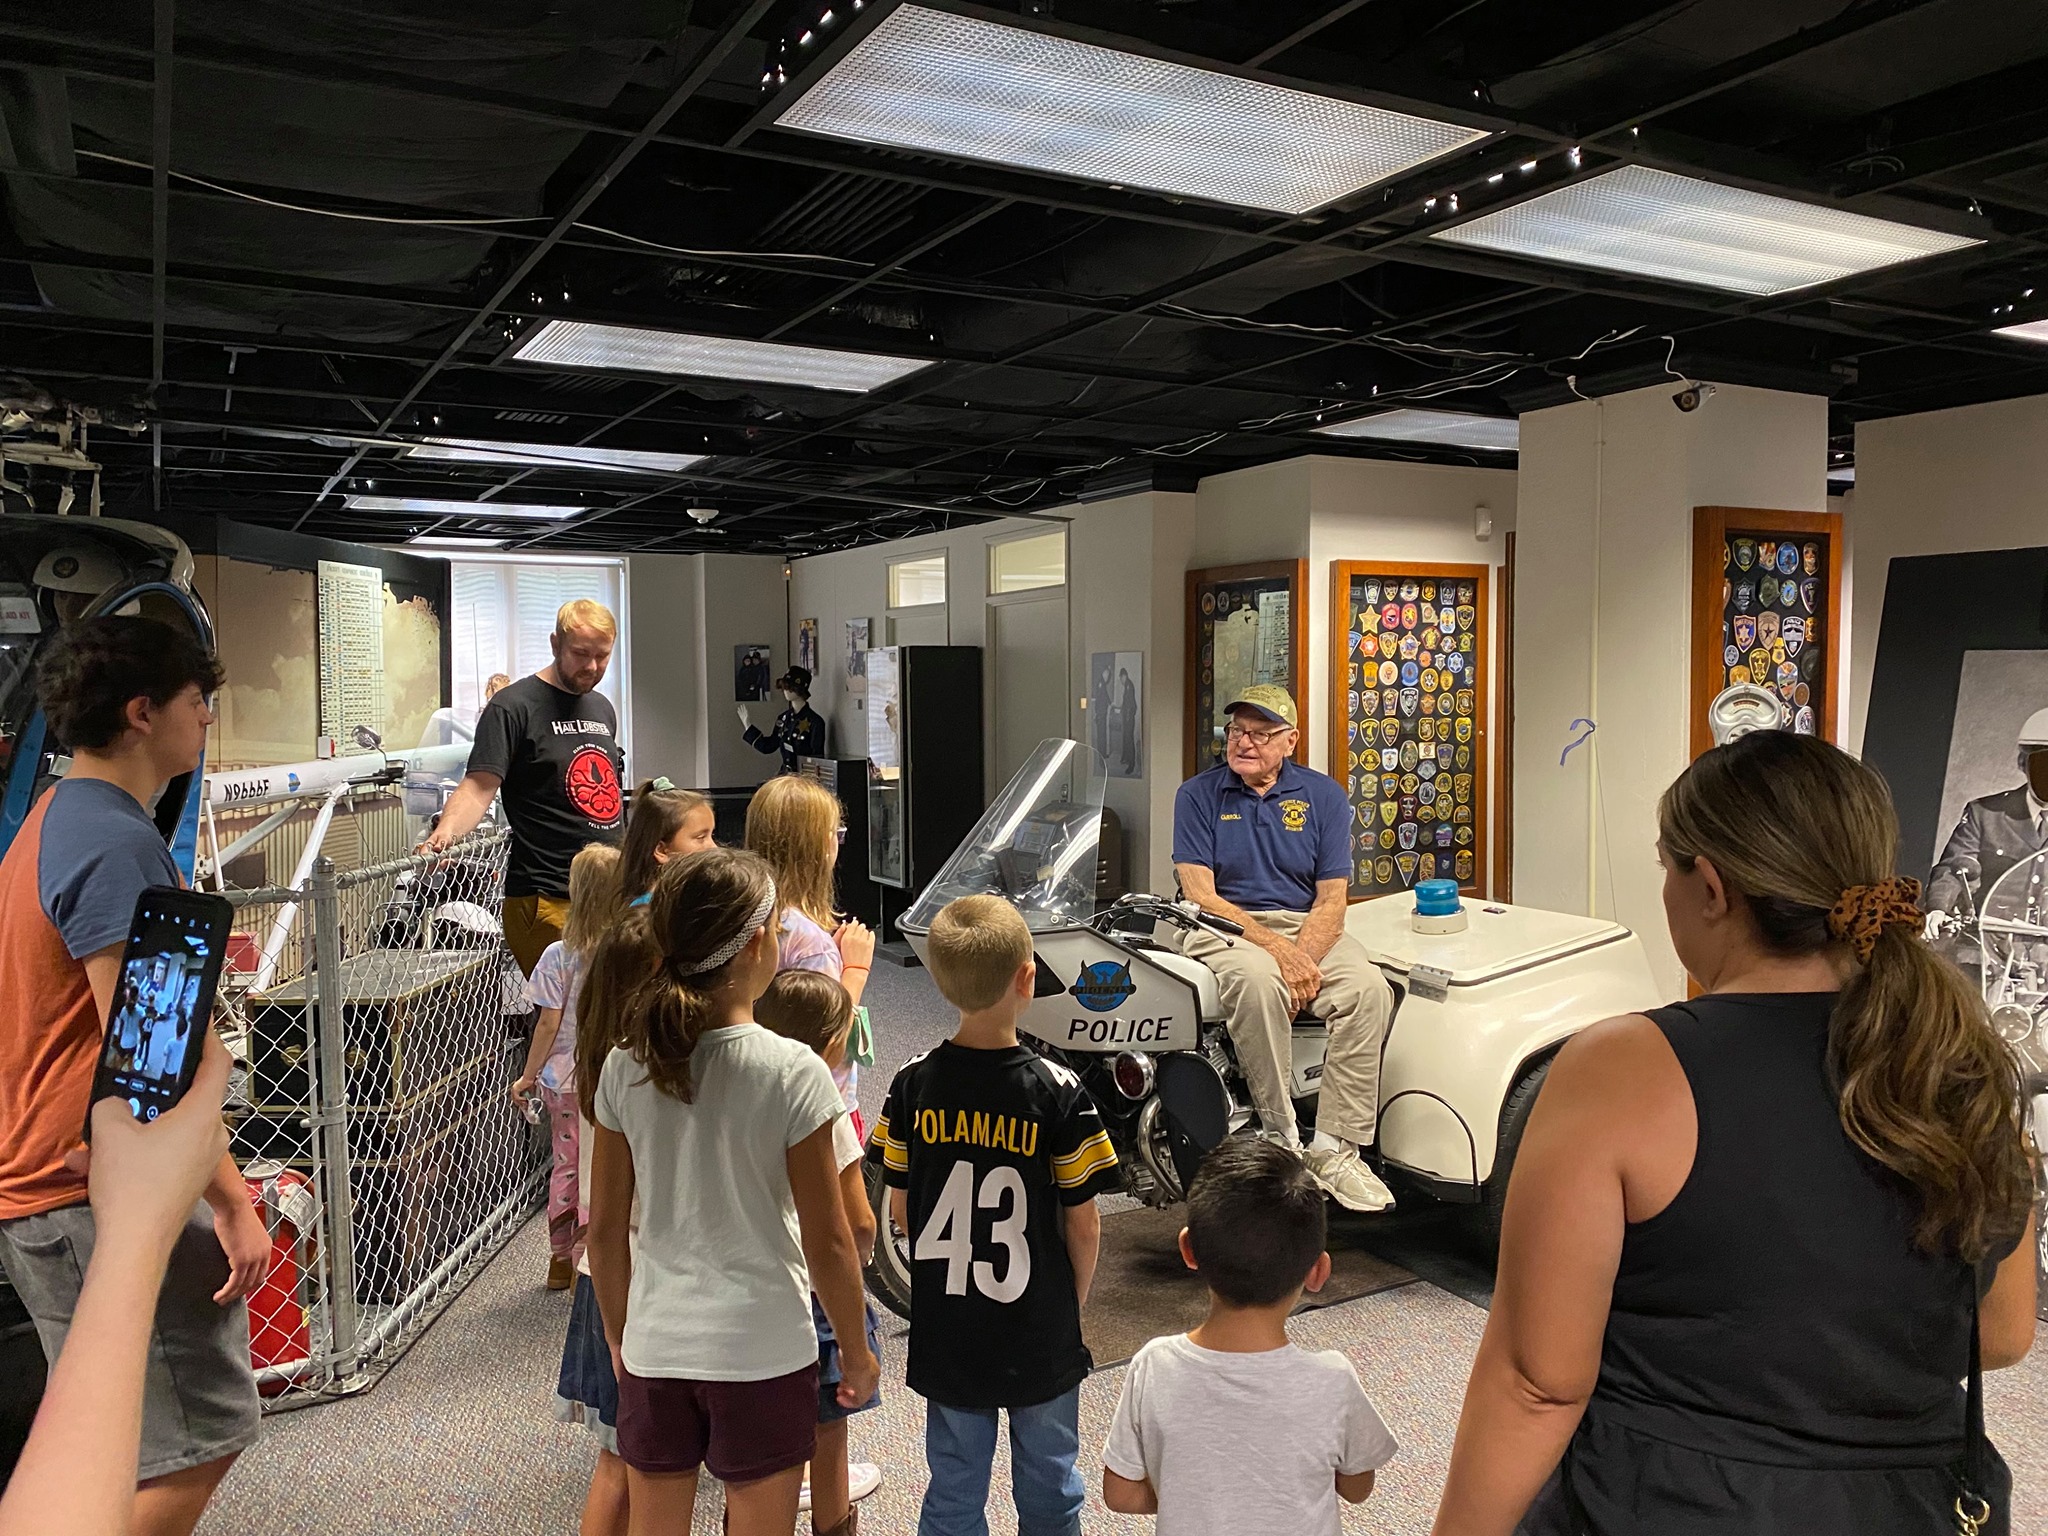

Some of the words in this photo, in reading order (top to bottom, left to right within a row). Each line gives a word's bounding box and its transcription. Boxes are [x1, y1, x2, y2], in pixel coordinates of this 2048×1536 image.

[551, 720, 577, 735] HAIL
[576, 719, 611, 736] LOBSTER
[1068, 1016, 1173, 1043] POLICE
[1040, 1057, 1081, 1089] 4
[915, 1160, 1031, 1304] 43
